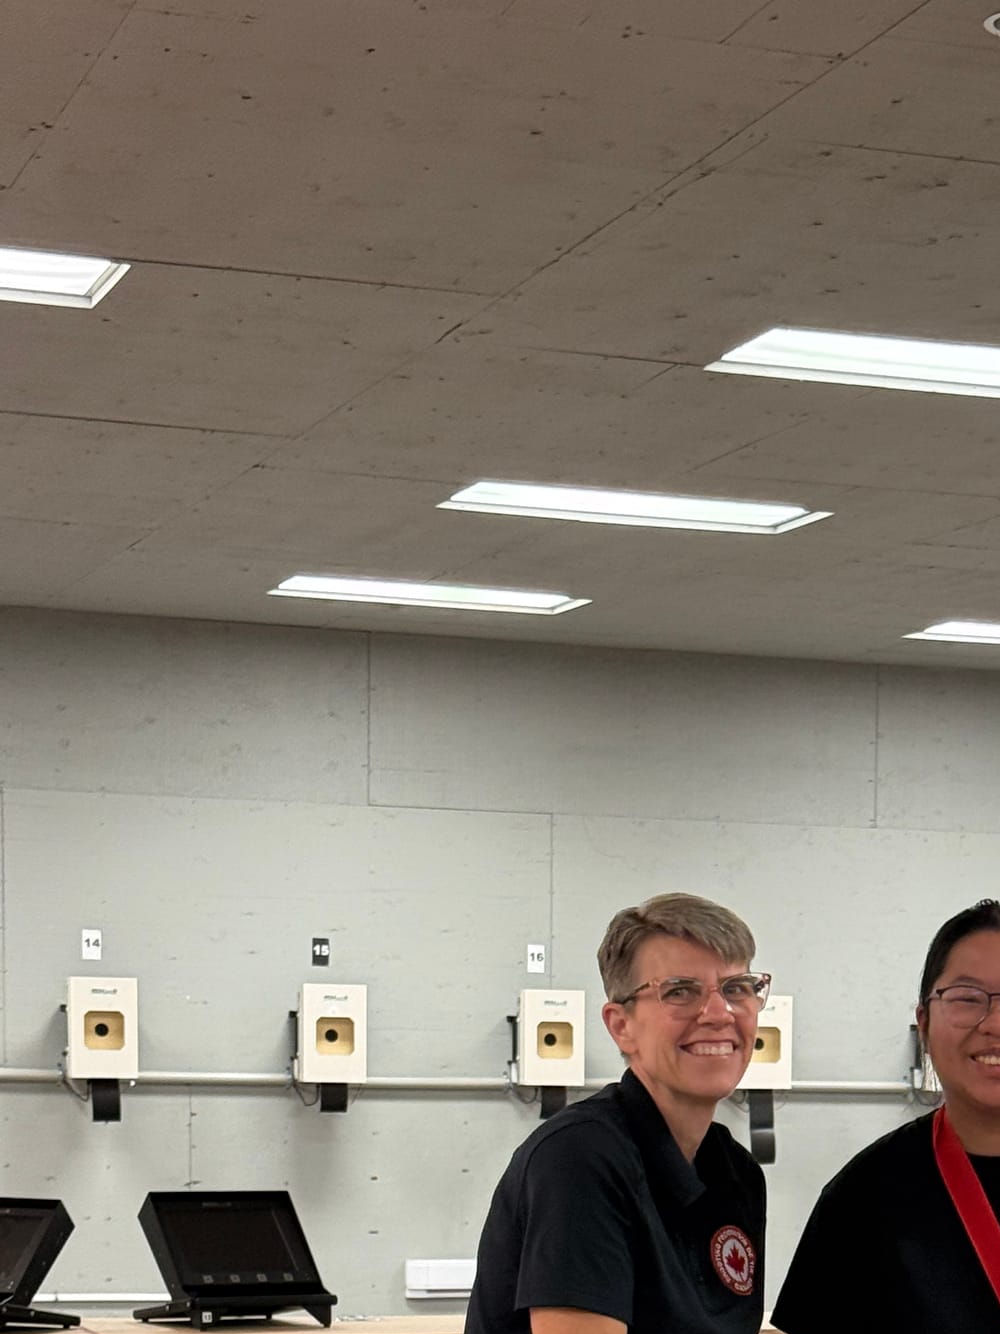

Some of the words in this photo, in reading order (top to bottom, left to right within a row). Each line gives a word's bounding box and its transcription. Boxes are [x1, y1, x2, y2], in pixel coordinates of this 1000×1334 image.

[85, 938, 100, 947] 14
[313, 944, 329, 955] 15
[529, 952, 544, 962] 16
